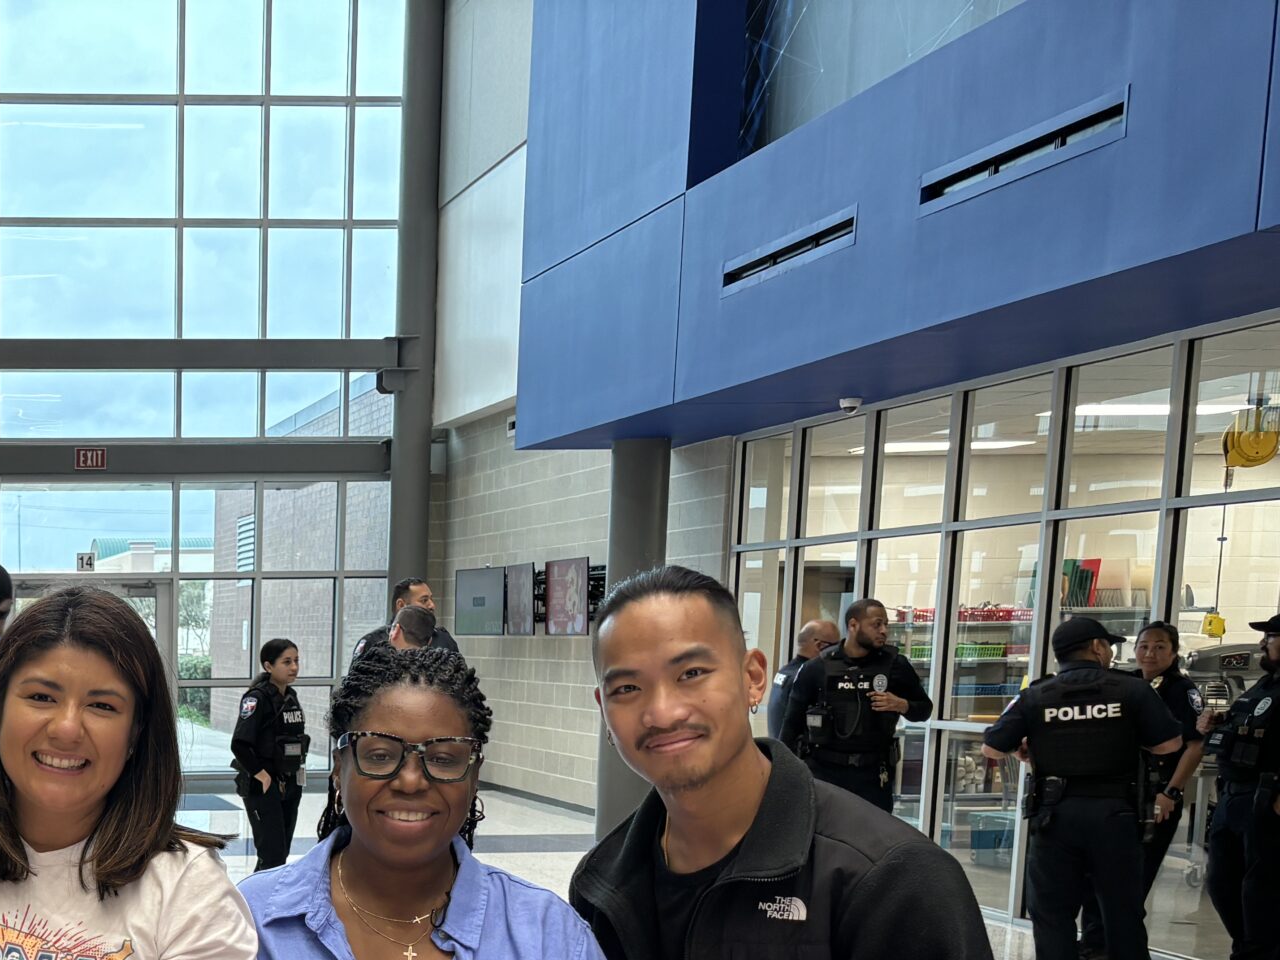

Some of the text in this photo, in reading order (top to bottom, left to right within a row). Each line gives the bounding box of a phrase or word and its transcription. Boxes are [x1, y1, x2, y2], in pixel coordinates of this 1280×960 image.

[80, 451, 103, 467] EXIT
[78, 555, 93, 569] 14
[838, 682, 870, 690] POLCE
[1044, 703, 1122, 722] POLICE
[774, 896, 792, 905] THE
[758, 902, 791, 912] NORTH
[767, 910, 790, 919] FACE
